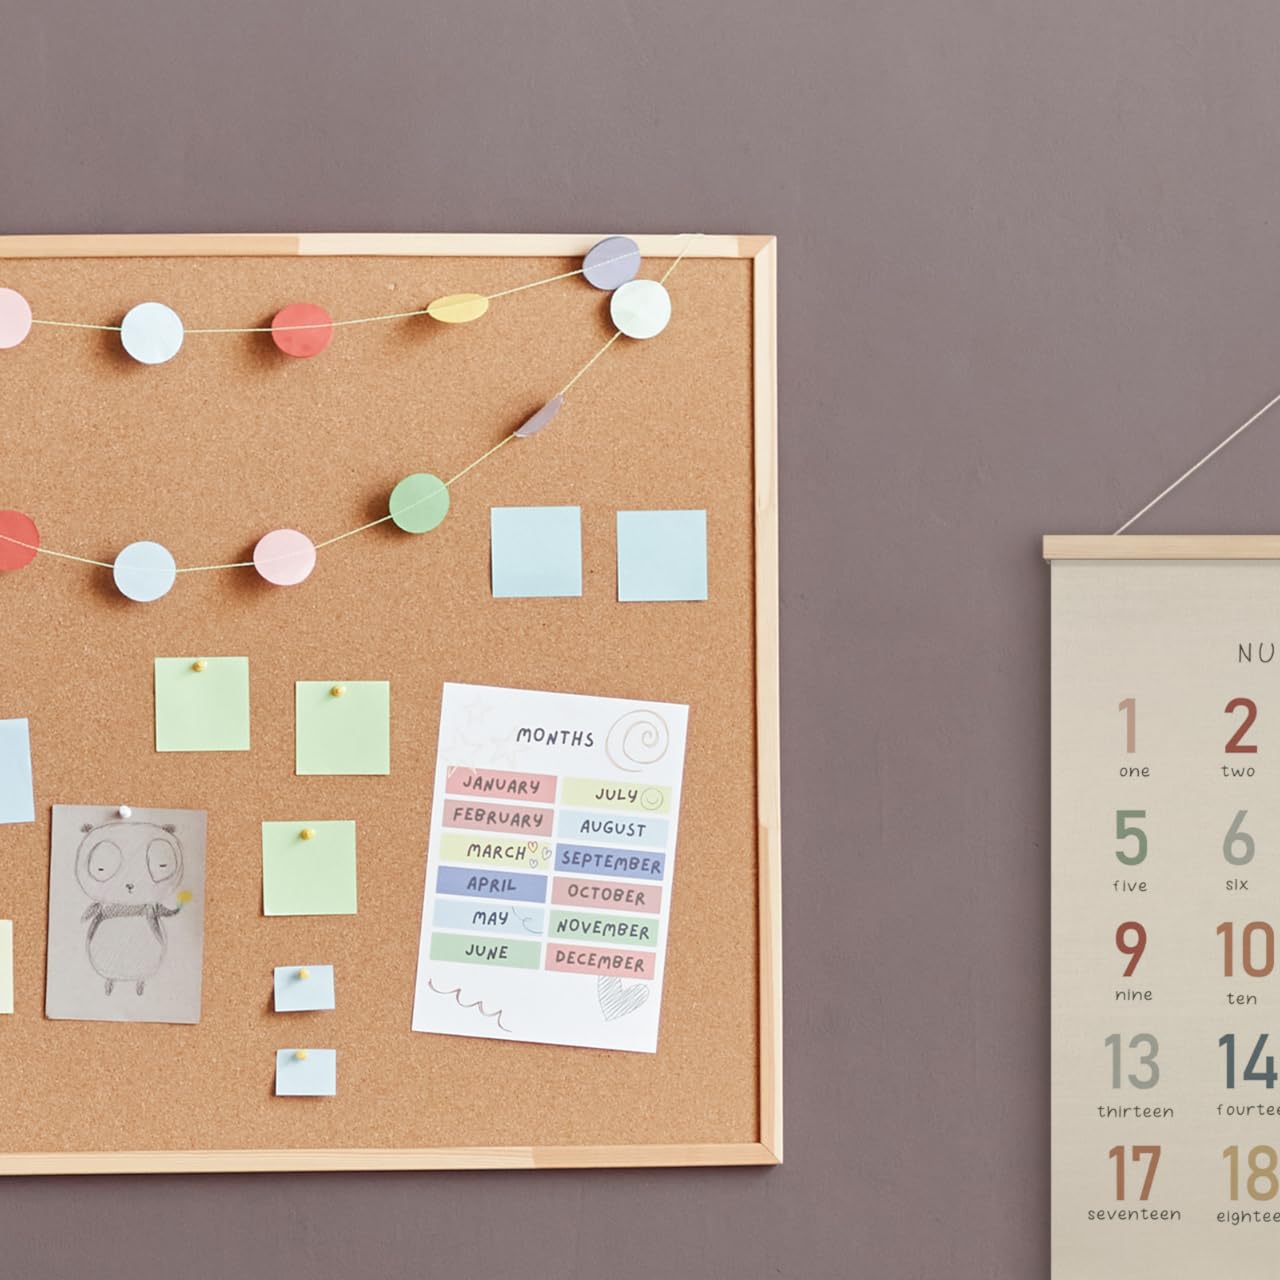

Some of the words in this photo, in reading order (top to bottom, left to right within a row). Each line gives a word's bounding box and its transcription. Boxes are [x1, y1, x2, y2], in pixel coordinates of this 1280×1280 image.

[1119, 697, 1136, 753] 1
[1224, 697, 1258, 753] 2
[517, 727, 594, 747] MONTHS
[1119, 766, 1151, 778] one
[1220, 764, 1256, 778] two
[463, 776, 540, 794] JANUARY
[595, 788, 638, 802] JULY
[453, 808, 543, 828] FEBRUARY
[580, 820, 646, 837] AUGUST
[1116, 810, 1147, 865] 5
[1223, 810, 1254, 865] 6
[467, 843, 526, 860] MARCH
[562, 851, 661, 874] SEPTEMBER
[467, 876, 517, 891] APRIL
[1112, 879, 1148, 893] five
[1225, 878, 1249, 891] six
[568, 884, 645, 905] OCTOBER
[472, 911, 508, 925] MAY
[557, 919, 649, 939] NOVEMBER
[466, 944, 508, 959] JUNE
[1115, 921, 1147, 977] 9
[1216, 921, 1274, 977] 10
[555, 950, 645, 972] DECEMBER
[1115, 988, 1153, 1001] nine
[1226, 992, 1257, 1006] ten
[1105, 1034, 1159, 1089] 13
[1219, 1034, 1278, 1089] 14
[1096, 1105, 1174, 1118] thirteen
[1109, 1145, 1161, 1200] 17
[1223, 1145, 1279, 1201] 18
[1087, 1208, 1181, 1221] seventeen
